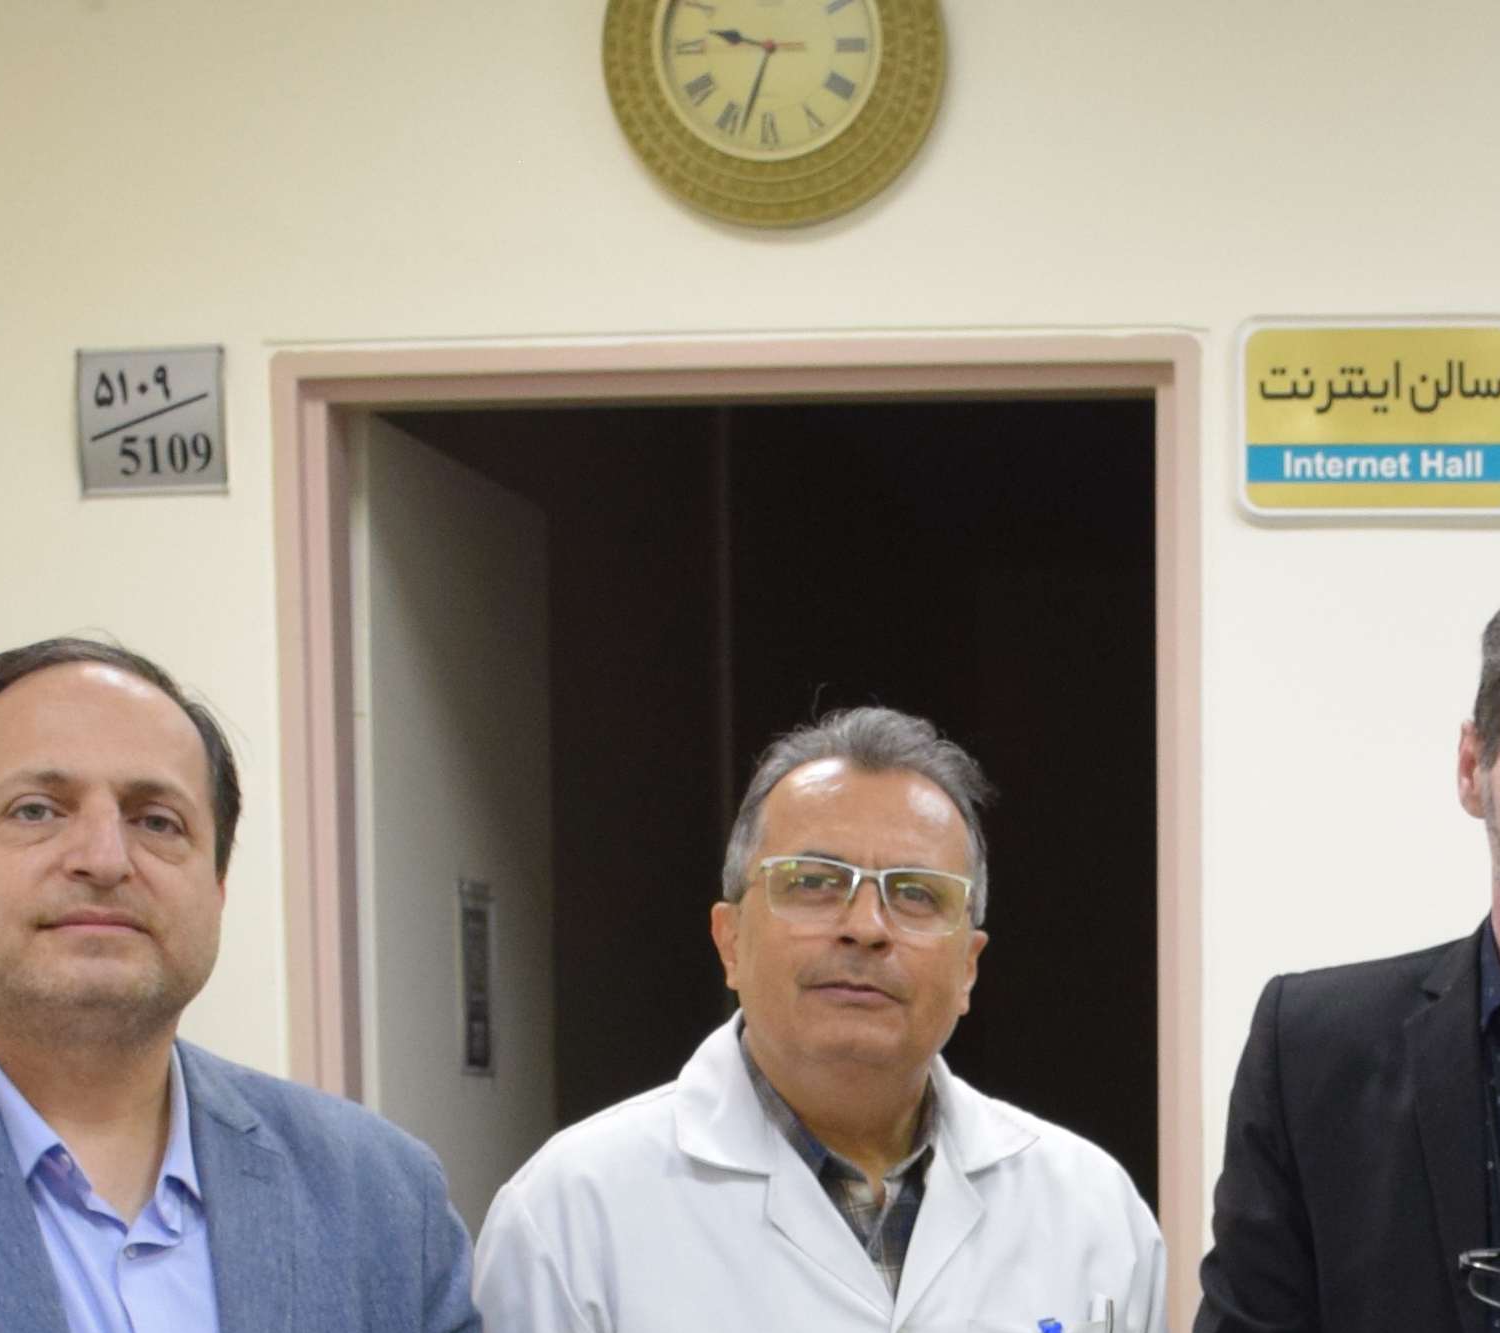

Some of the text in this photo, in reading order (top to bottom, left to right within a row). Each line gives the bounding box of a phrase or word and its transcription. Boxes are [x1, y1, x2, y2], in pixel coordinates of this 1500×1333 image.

[94, 364, 170, 408] ۵۱۰۹
[1260, 360, 1401, 414] اینترنت
[119, 432, 213, 476] 5109
[1283, 451, 1484, 479] Internet Hall
